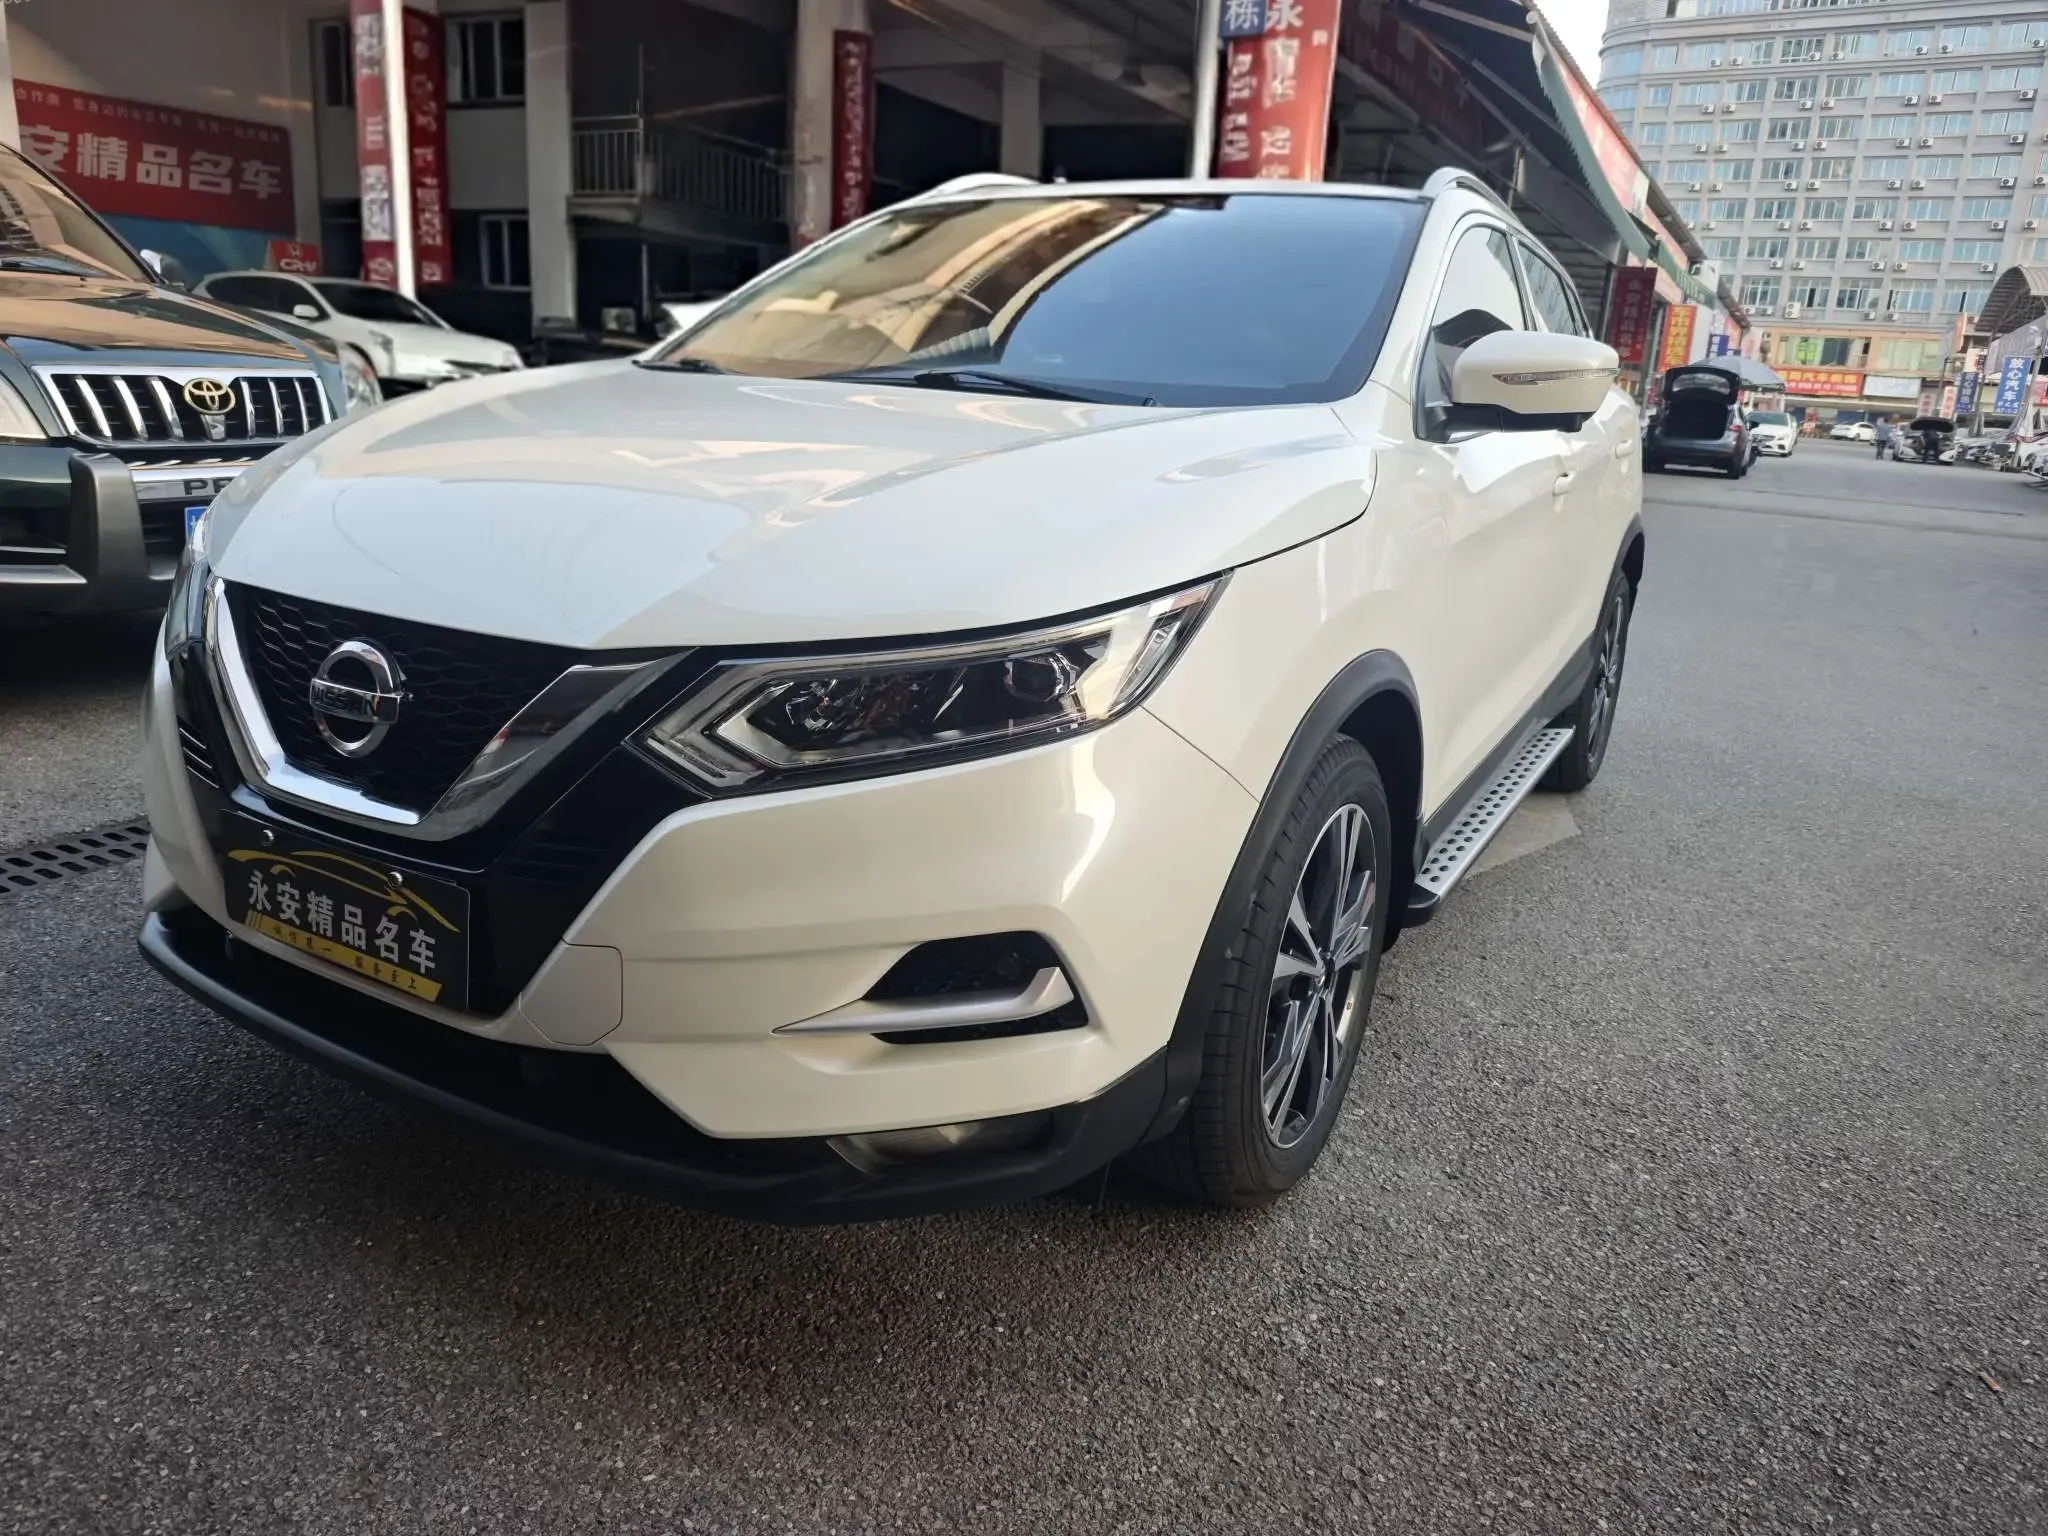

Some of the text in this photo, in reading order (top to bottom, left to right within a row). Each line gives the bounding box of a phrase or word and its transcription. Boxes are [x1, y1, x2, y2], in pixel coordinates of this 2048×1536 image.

[311, 682, 380, 716] NISSAN
[248, 869, 436, 975] 永安精品名车
